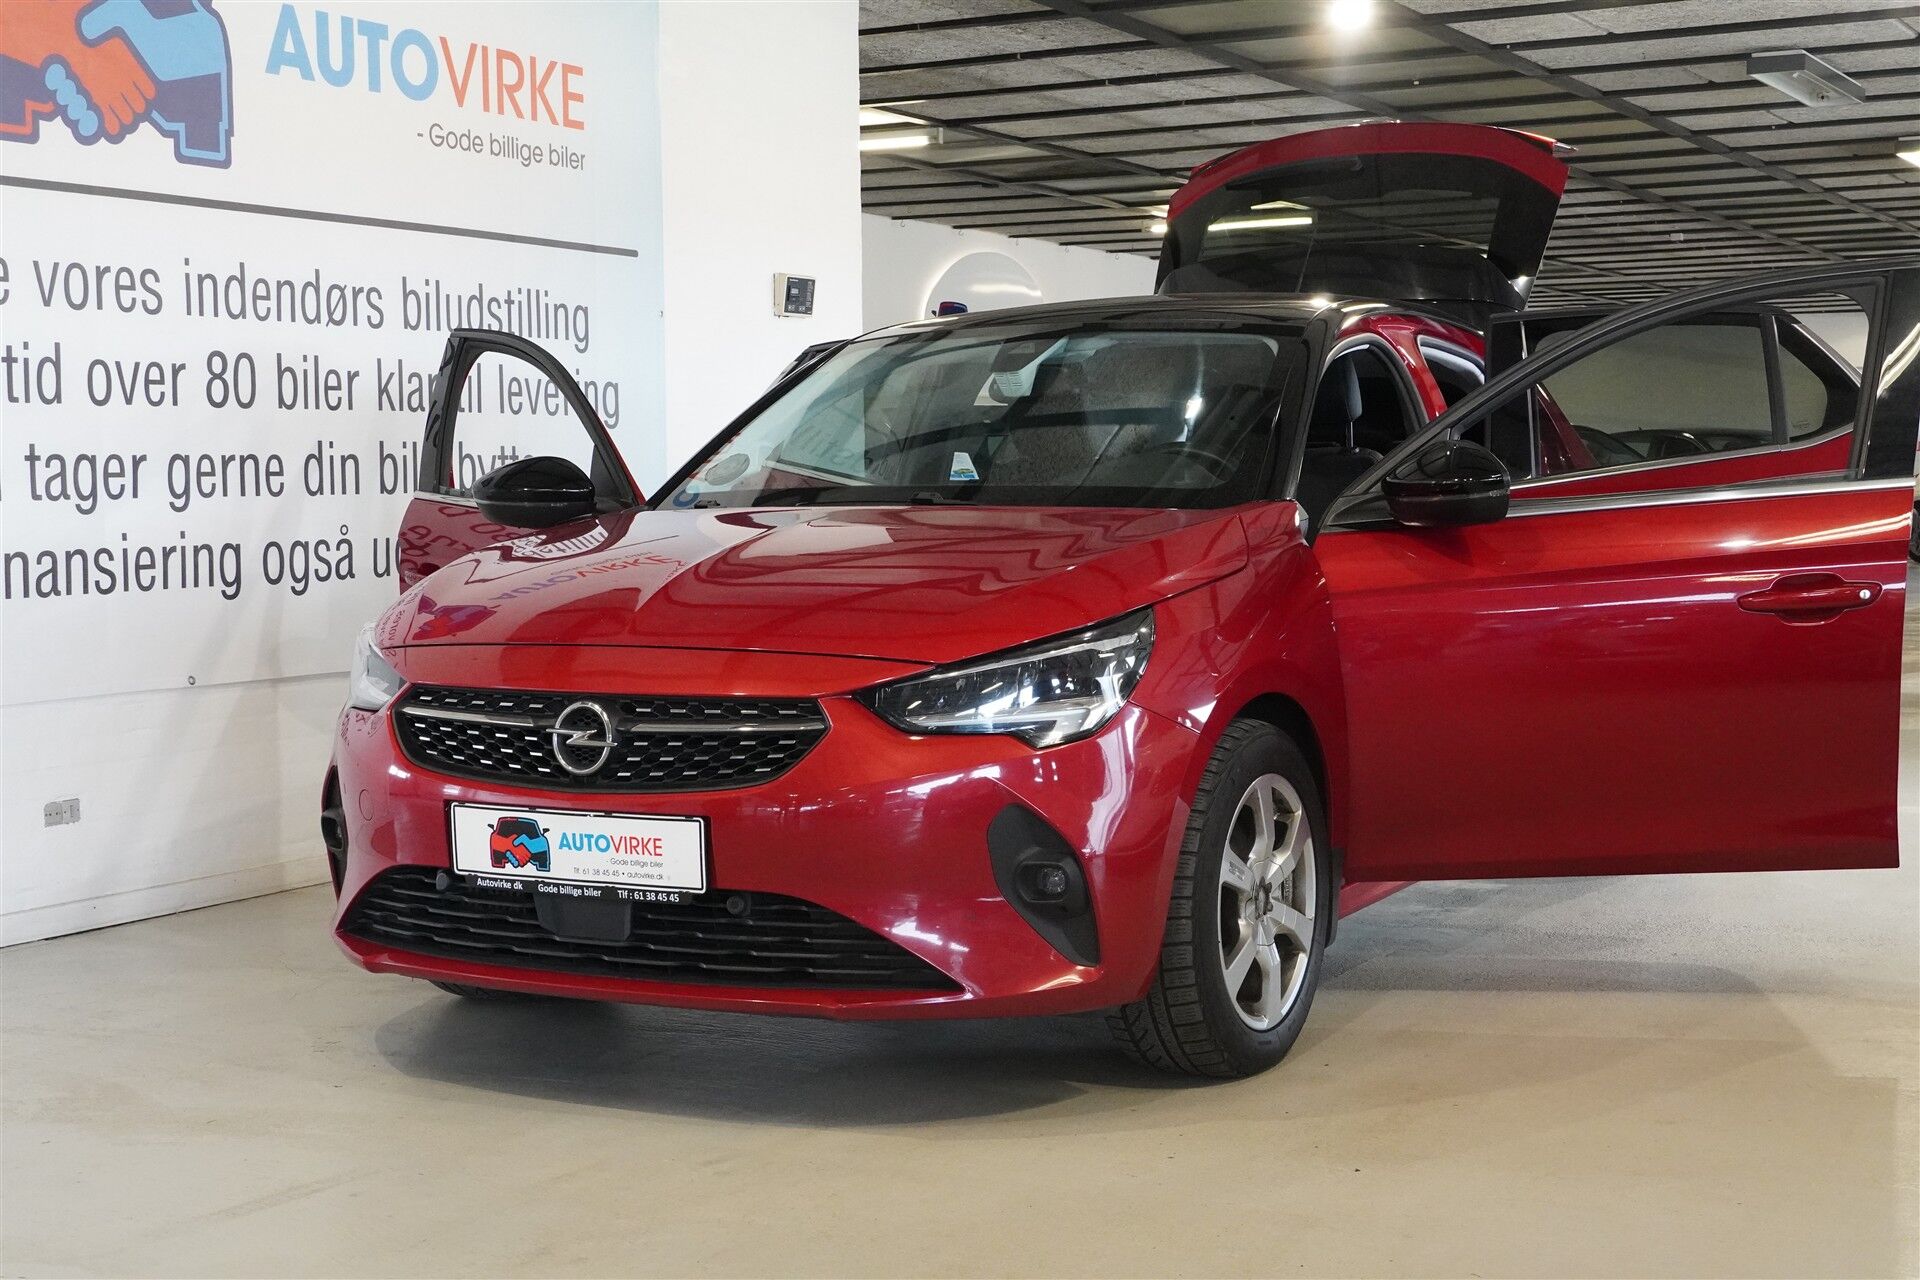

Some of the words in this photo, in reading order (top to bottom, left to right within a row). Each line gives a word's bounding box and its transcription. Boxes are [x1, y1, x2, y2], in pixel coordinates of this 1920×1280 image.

[266, 4, 585, 131] AUTOVIRKE
[429, 122, 484, 154] Gode
[489, 132, 544, 167] billige
[548, 143, 586, 171] biler
[32, 260, 163, 316] vores
[184, 257, 385, 330] indendørs
[401, 275, 590, 354] biludstilling
[87, 358, 187, 409] over
[205, 350, 257, 410] 80
[276, 353, 360, 412] biler
[457, 362, 482, 414] il
[23, 443, 148, 516] tager
[167, 453, 285, 513] gerne
[303, 440, 361, 497] din
[378, 440, 418, 496] bil
[4, 531, 242, 601] nansiering
[262, 524, 356, 598] også
[558, 831, 663, 857] AUTOVIRKE
[582, 867, 590, 875] 61
[592, 868, 600, 876] 38
[610, 858, 629, 866] Gode
[630, 859, 648, 868] billige
[477, 877, 511, 889] Autovirke
[513, 881, 523, 890] dk
[538, 884, 558, 893] Gode
[559, 885, 582, 897] billige
[584, 887, 602, 897] biler
[634, 891, 644, 900] 61
[646, 892, 656, 901] 38
[657, 893, 667, 902] 45
[669, 893, 679, 902] 45
